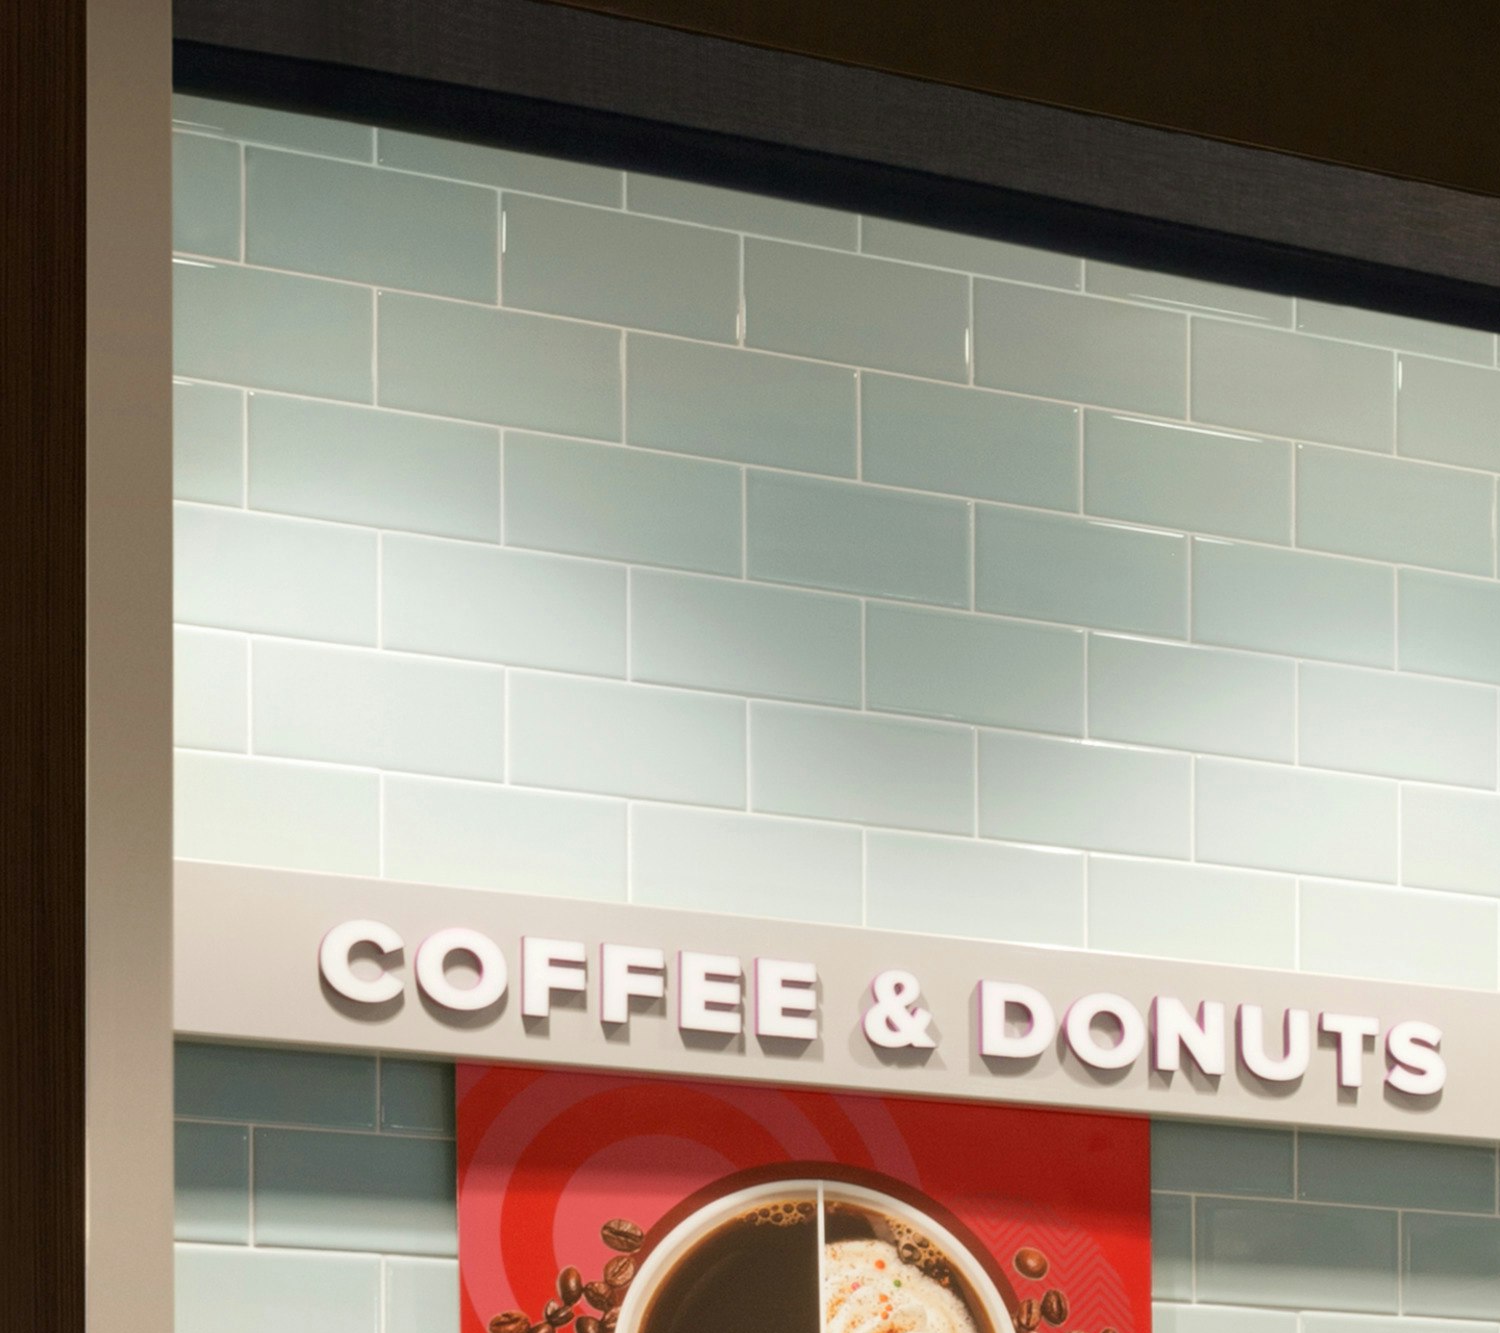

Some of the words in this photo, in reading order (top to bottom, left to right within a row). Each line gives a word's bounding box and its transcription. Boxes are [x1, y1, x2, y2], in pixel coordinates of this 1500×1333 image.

[318, 918, 819, 1041] COFFEE
[861, 969, 937, 1049] &
[976, 978, 1448, 1096] DONUTS
